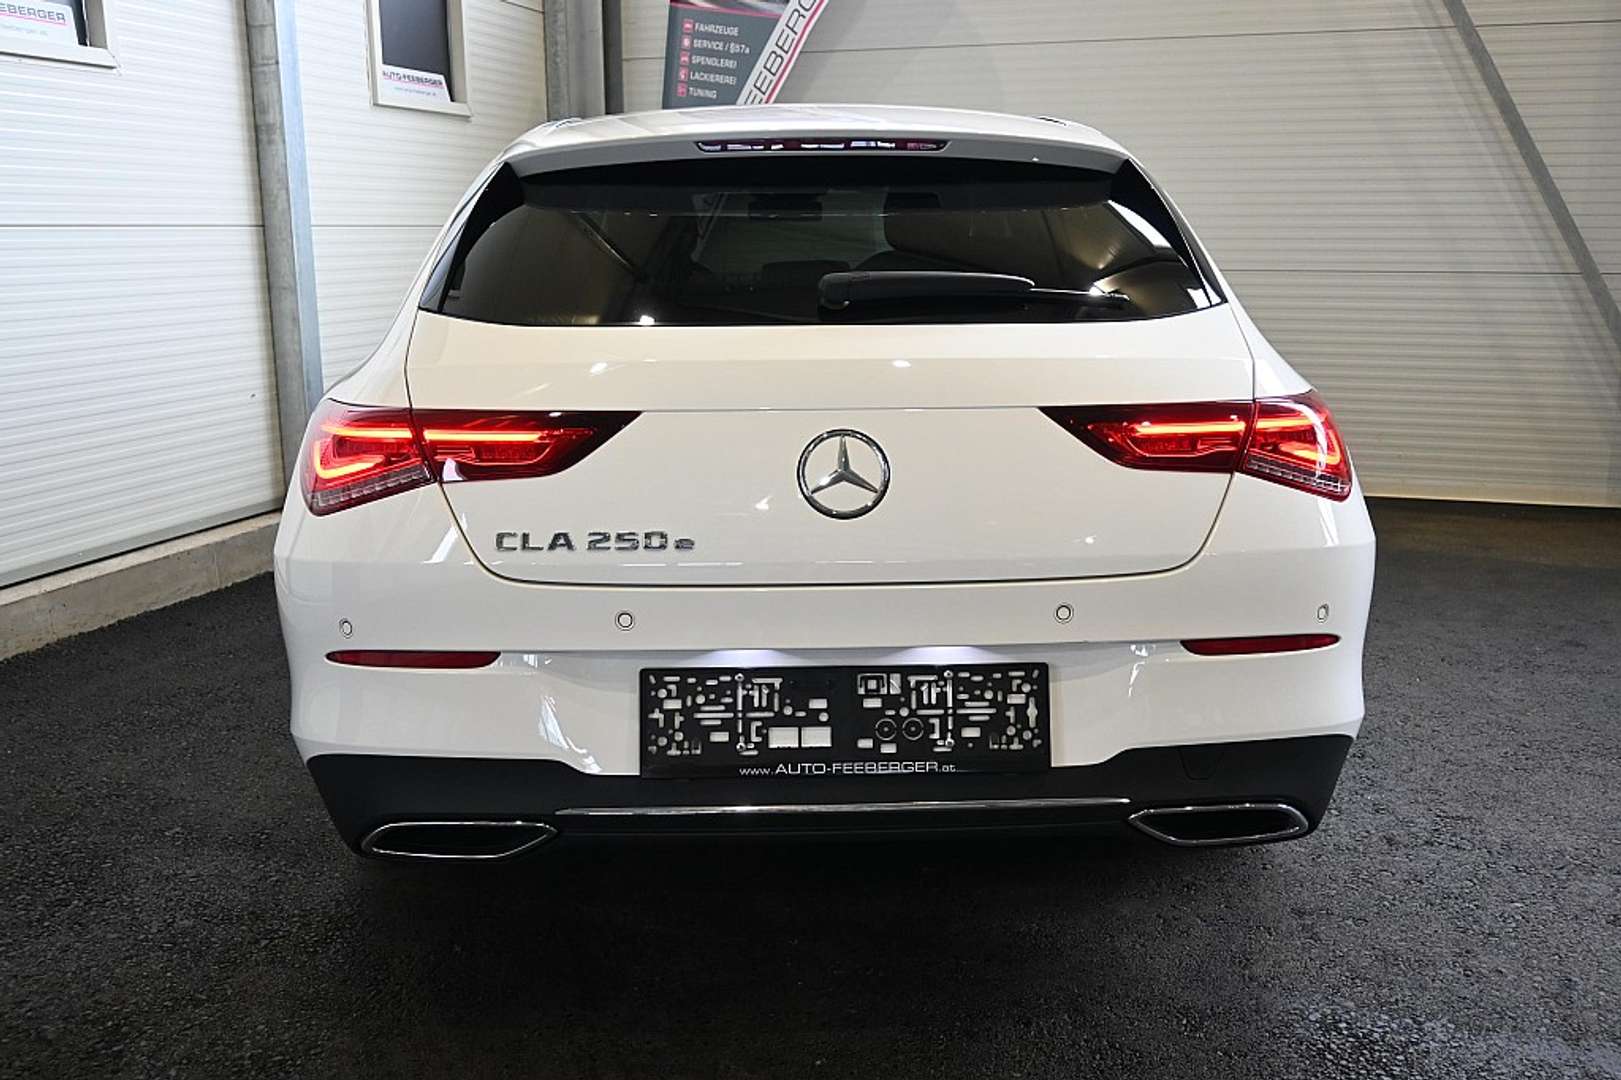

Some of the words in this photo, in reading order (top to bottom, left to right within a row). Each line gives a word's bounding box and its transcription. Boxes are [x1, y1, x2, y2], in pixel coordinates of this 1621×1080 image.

[694, 22, 739, 36] FAHRZEUGE
[693, 39, 723, 51] SERVICE
[691, 55, 737, 69] SPENGLEREI
[690, 71, 737, 86] LACKIEREREI
[688, 87, 717, 99] TUNING
[495, 531, 575, 551] CLA
[586, 531, 668, 551] 250
[673, 538, 696, 550] e
[739, 761, 956, 776] www.AUTO-FEEBERGER.at
